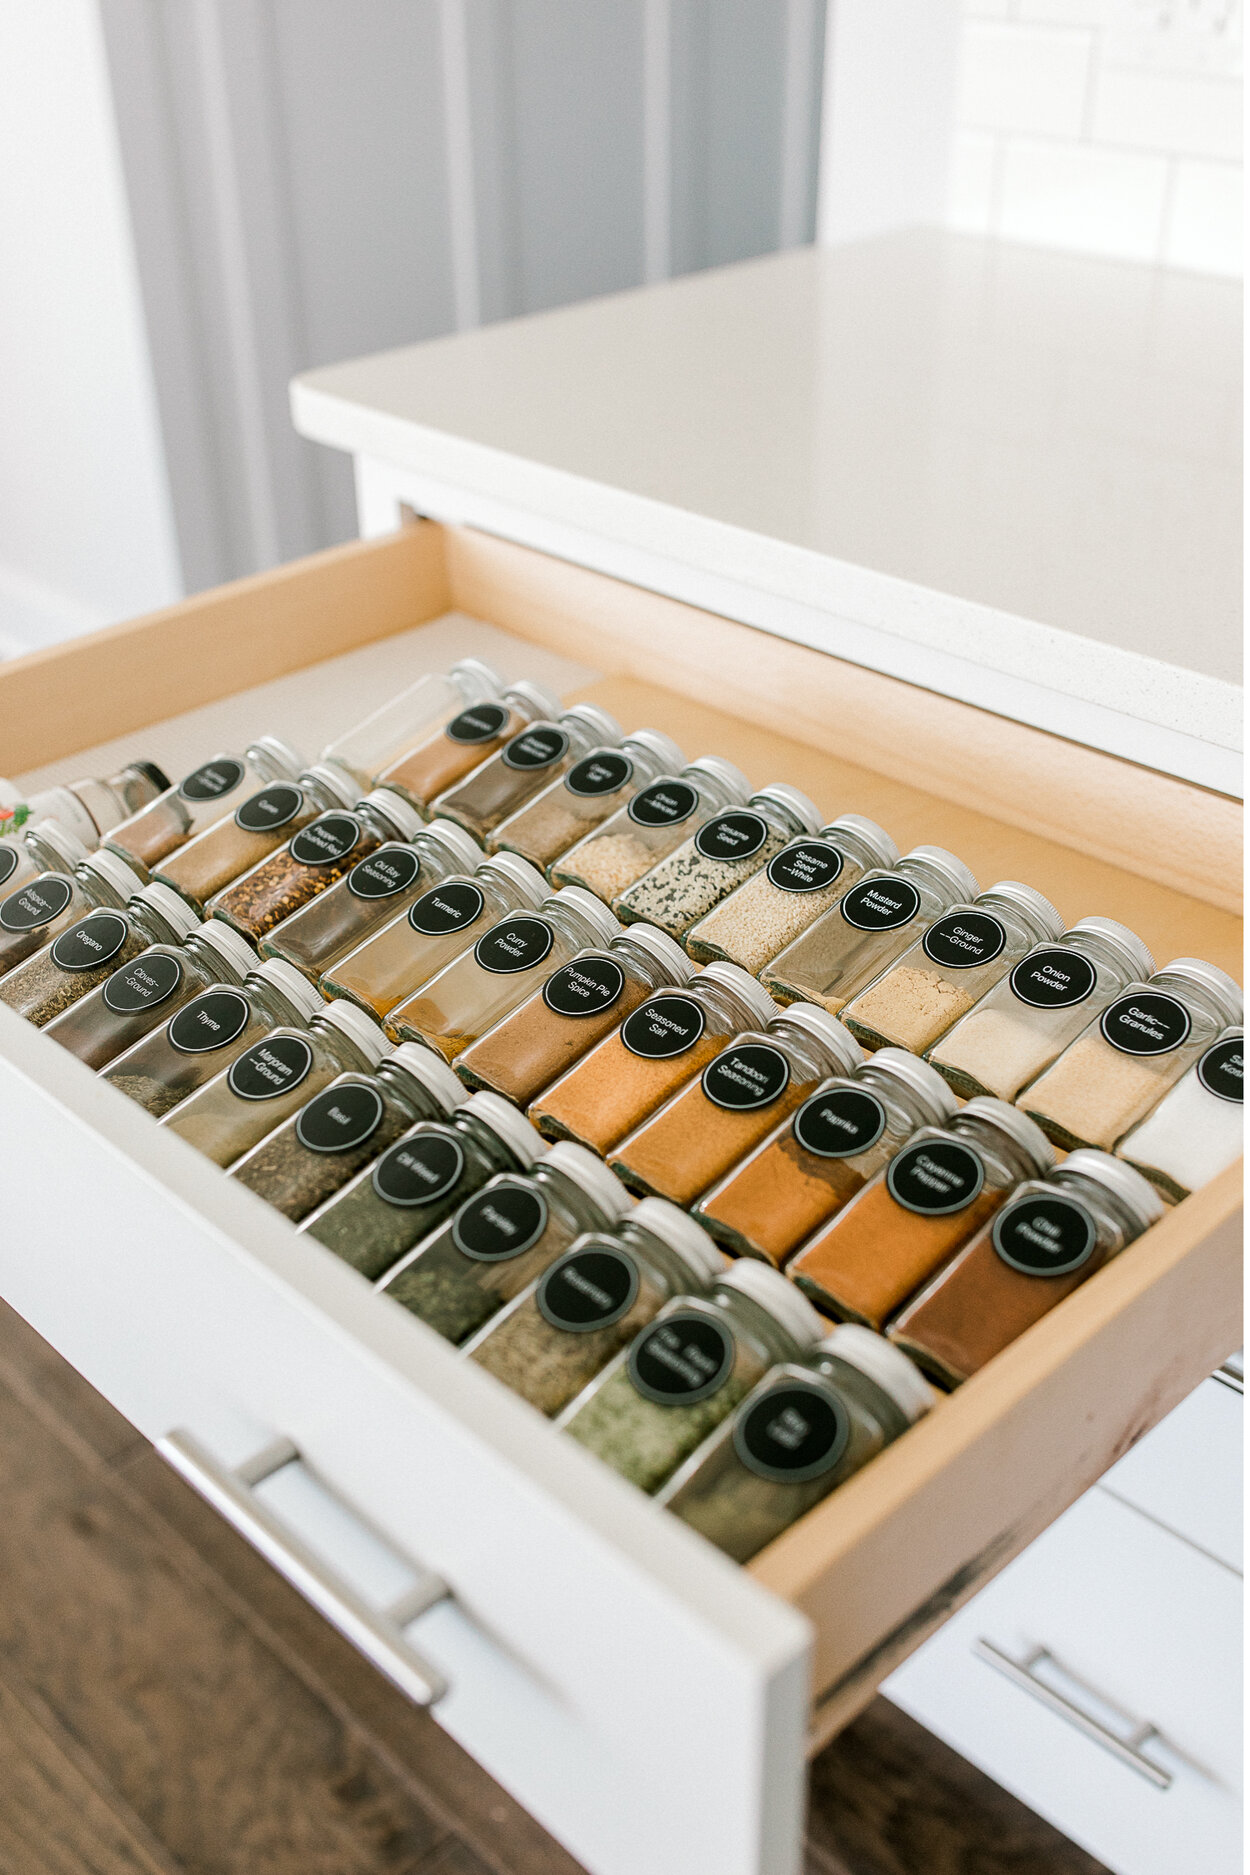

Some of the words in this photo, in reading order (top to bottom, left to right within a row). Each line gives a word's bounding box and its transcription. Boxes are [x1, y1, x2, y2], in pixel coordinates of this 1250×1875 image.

[716, 832, 740, 846] Seed
[718, 823, 749, 841] Sesame
[374, 860, 387, 871] Old
[386, 865, 400, 879] Bay
[793, 860, 817, 874] Seed
[795, 851, 828, 870] Sesame
[362, 865, 396, 889] Seasoning
[18, 897, 41, 916] Ground
[431, 897, 462, 919] Turmeric
[860, 896, 893, 916] Powder
[866, 889, 903, 911] Mustard
[76, 929, 103, 952] Oregano
[506, 933, 528, 949] Curry
[952, 926, 984, 944] Ginger
[494, 939, 524, 958] Powder
[563, 966, 598, 990] Pumpkin
[595, 983, 611, 998] Pie
[1030, 971, 1068, 991] Powder
[1042, 965, 1071, 983] Onion
[567, 981, 591, 998] Spice
[196, 1010, 221, 1032] Thyme
[644, 1008, 689, 1037] Seasoned
[648, 1023, 668, 1039] Salt
[1119, 1014, 1164, 1040] Granules
[257, 1048, 293, 1076] Marjoram
[717, 1064, 765, 1097] Seasoning
[819, 1108, 859, 1135] Paprika
[916, 1154, 965, 1189] Cayenne
